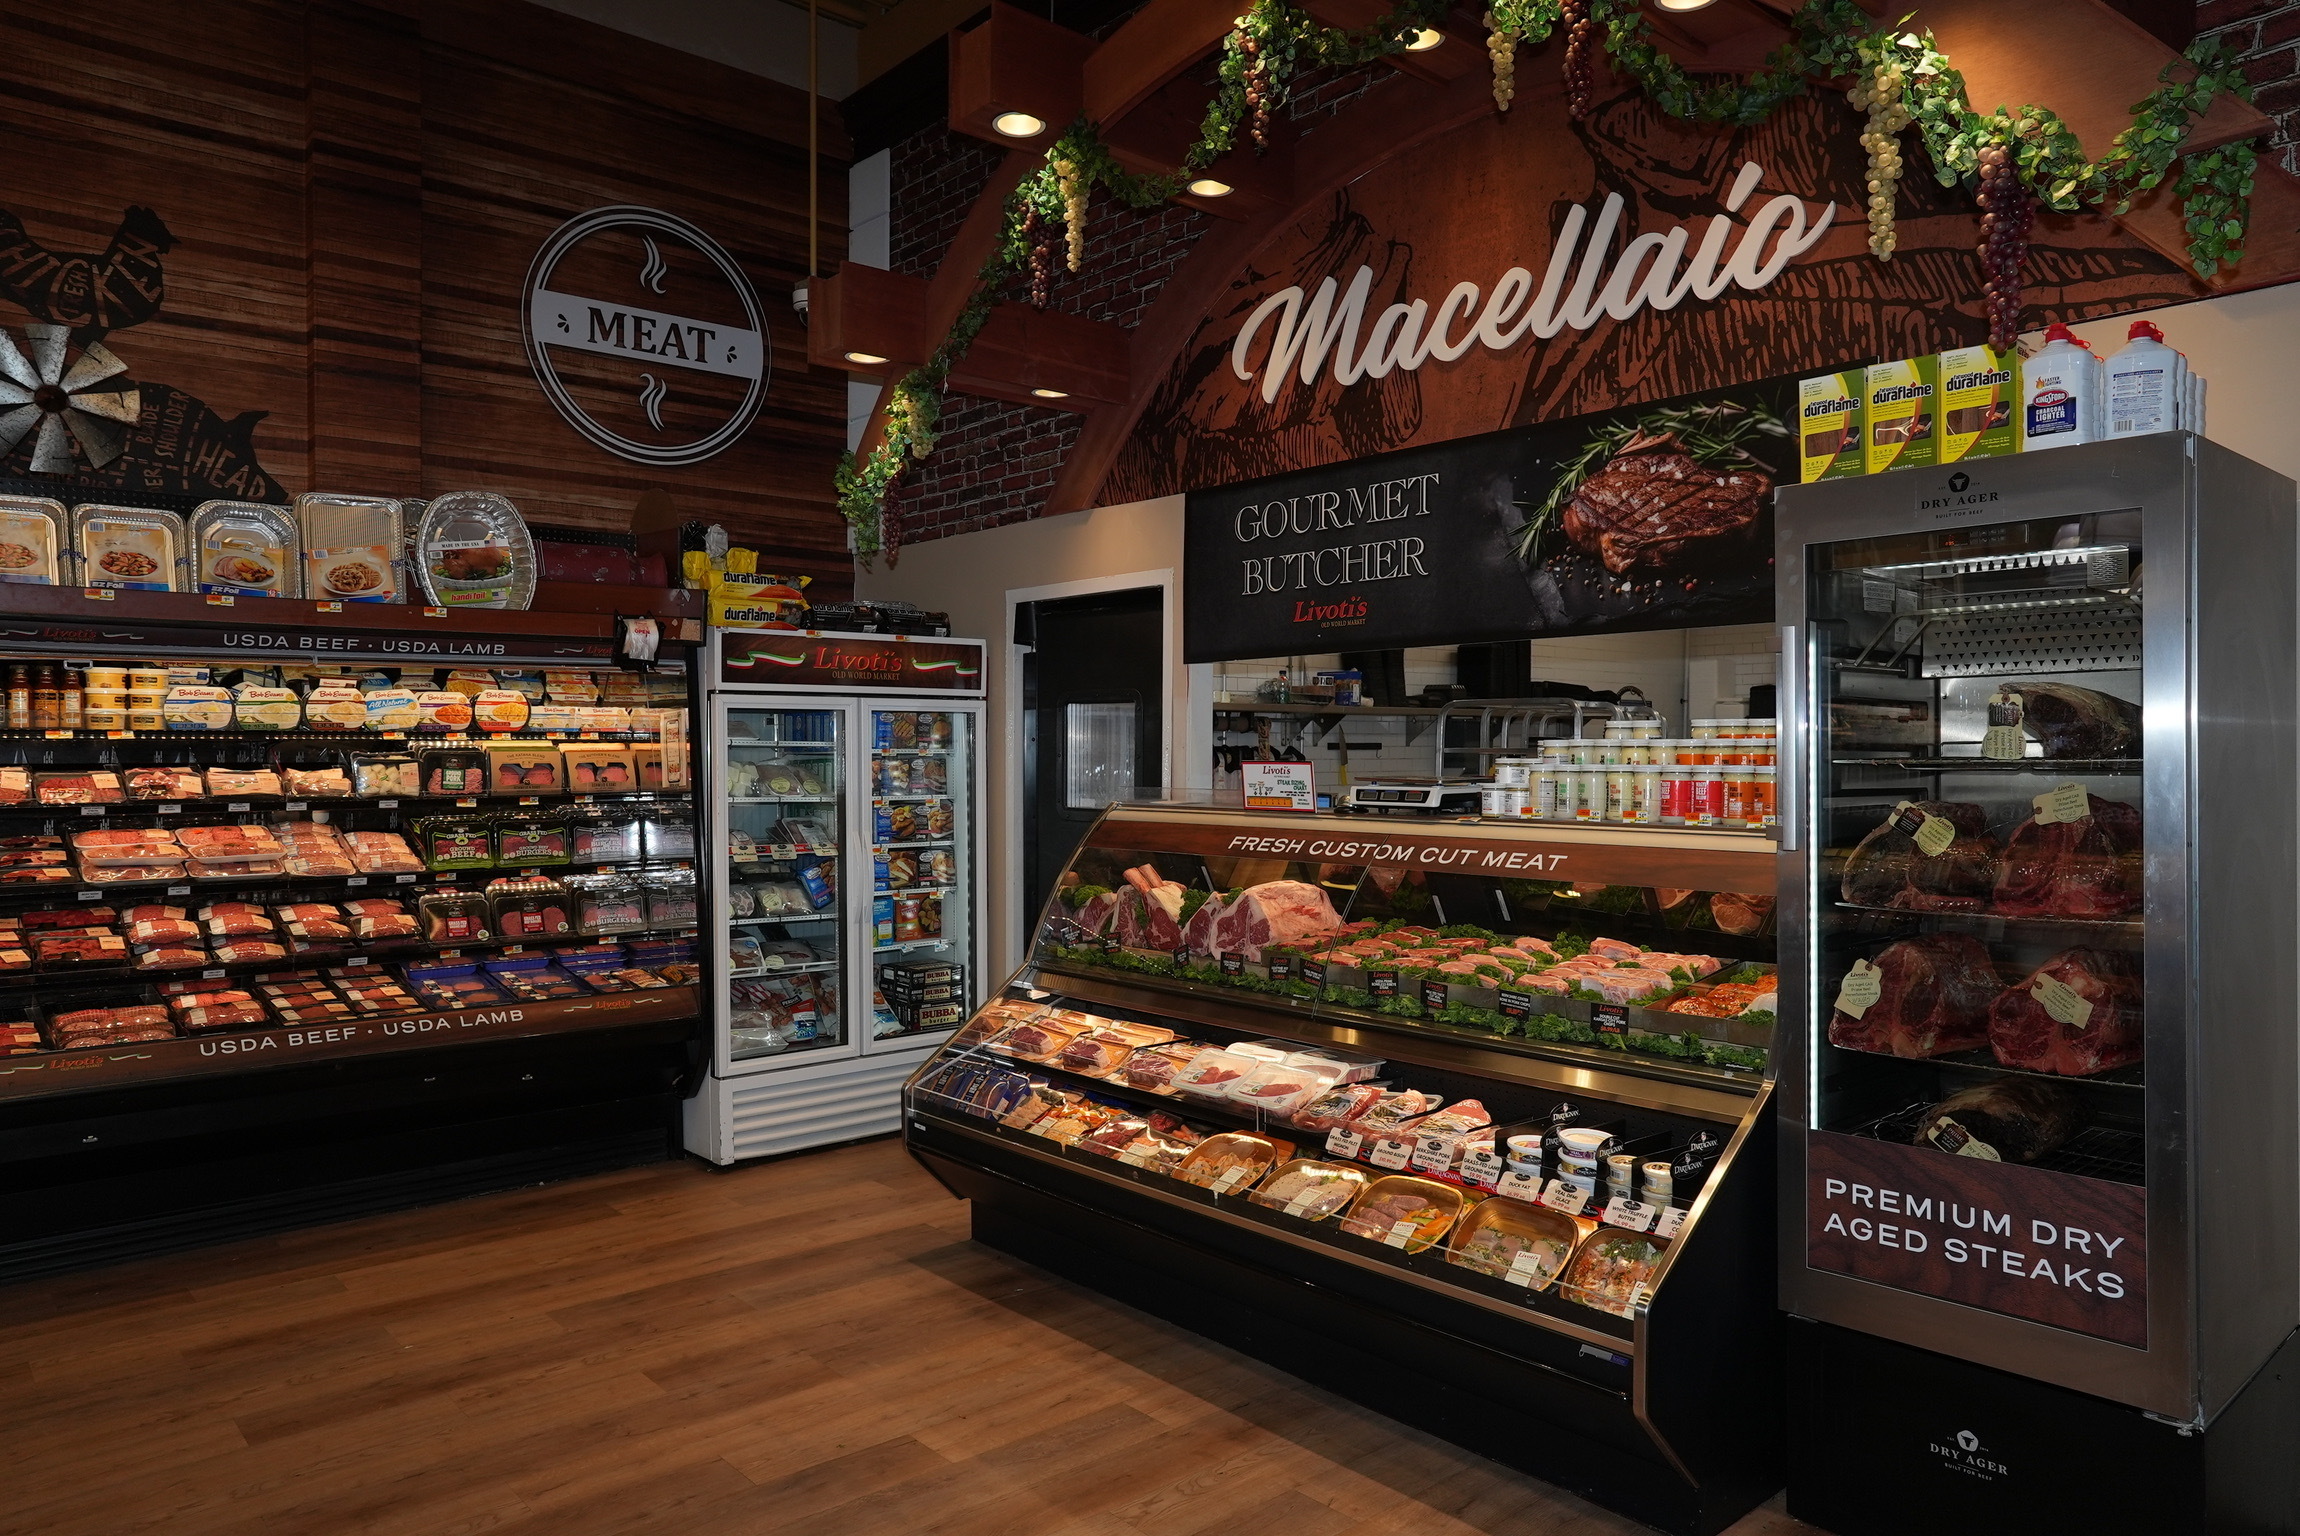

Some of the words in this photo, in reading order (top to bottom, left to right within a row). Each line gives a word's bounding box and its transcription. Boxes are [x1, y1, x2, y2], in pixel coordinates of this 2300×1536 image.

[0, 229, 163, 328] HICKEN
[586, 304, 717, 364] MEAT
[1946, 370, 2011, 392] duraflame
[1872, 384, 1933, 405] duraflame
[2035, 393, 2066, 404] KINGSFORD
[1804, 397, 1860, 418] duraflame
[2035, 406, 2065, 415] CHARCOAL
[136, 401, 160, 445] BLADE
[2035, 412, 2066, 422] LIGHTER
[155, 391, 189, 459] SHOULDER
[193, 438, 266, 499] HEAD
[1921, 497, 1951, 509] DRY
[1957, 492, 1999, 505] AGER
[1234, 472, 1441, 543] GOURMET
[1241, 535, 1429, 596] BUTCHER
[723, 571, 777, 587] duraflame
[222, 586, 239, 594] Foil
[451, 593, 472, 601] handi
[473, 591, 487, 600] foil
[724, 606, 776, 622] duraflame
[1293, 595, 1368, 623] Livoti's
[1331, 620, 1346, 628] WORLD
[1347, 618, 1367, 627] MARKET
[223, 633, 289, 648] USDA
[299, 636, 360, 650] BEEF
[382, 640, 440, 654] USDA
[449, 642, 505, 655] LAMB
[813, 645, 903, 672] Livoti's
[832, 671, 847, 679] OLD
[848, 671, 871, 680] WORLD
[873, 672, 900, 681] MARKET
[381, 698, 409, 707] Natural
[1262, 765, 1291, 775] Livoti's
[451, 850, 475, 858] BEEF
[515, 849, 552, 857] BURGERS
[1228, 835, 1306, 854] FRESH
[1308, 840, 1416, 861] CUSTOM
[1418, 846, 1478, 865] CUT
[1481, 851, 1568, 871] MEAT
[597, 917, 630, 925] BURGERS
[926, 971, 949, 979] BUBBA
[925, 988, 949, 996] BUBBA
[921, 1007, 956, 1019] BUBBA
[199, 1037, 278, 1057] USDA
[288, 1027, 357, 1046] BEEF
[383, 1017, 451, 1036] USDA
[459, 1009, 524, 1028] LAMB
[1376, 1148, 1393, 1156] GROUND
[1393, 1151, 1406, 1159] BISON
[1416, 1146, 1438, 1157] BERKSHIRE
[1416, 1154, 1434, 1162] GROUND
[1463, 1157, 1488, 1168] GRASS-FED
[1464, 1164, 1483, 1174] GROUND
[1554, 1189, 1567, 1197] VEAL
[1566, 1192, 1578, 1200] DEMI
[1555, 1196, 1571, 1205] GLACE
[1612, 1205, 1627, 1214] WHITE
[1627, 1209, 1648, 1219] TRUFFLE
[1617, 1213, 1637, 1222] BUTTER
[1826, 1178, 2012, 1237] PREMIUM
[2032, 1219, 2125, 1259] DRY
[1517, 1251, 1538, 1261] Livoti's
[1823, 1212, 1928, 1253] AGED
[1944, 1238, 2125, 1299] STEAKS
[1930, 1443, 1960, 1460] DRY
[1966, 1455, 2009, 1476] AGER
[1945, 1462, 1961, 1471] BUILT
[1963, 1468, 1976, 1476] FOR
[1978, 1473, 1993, 1481] BEEF
